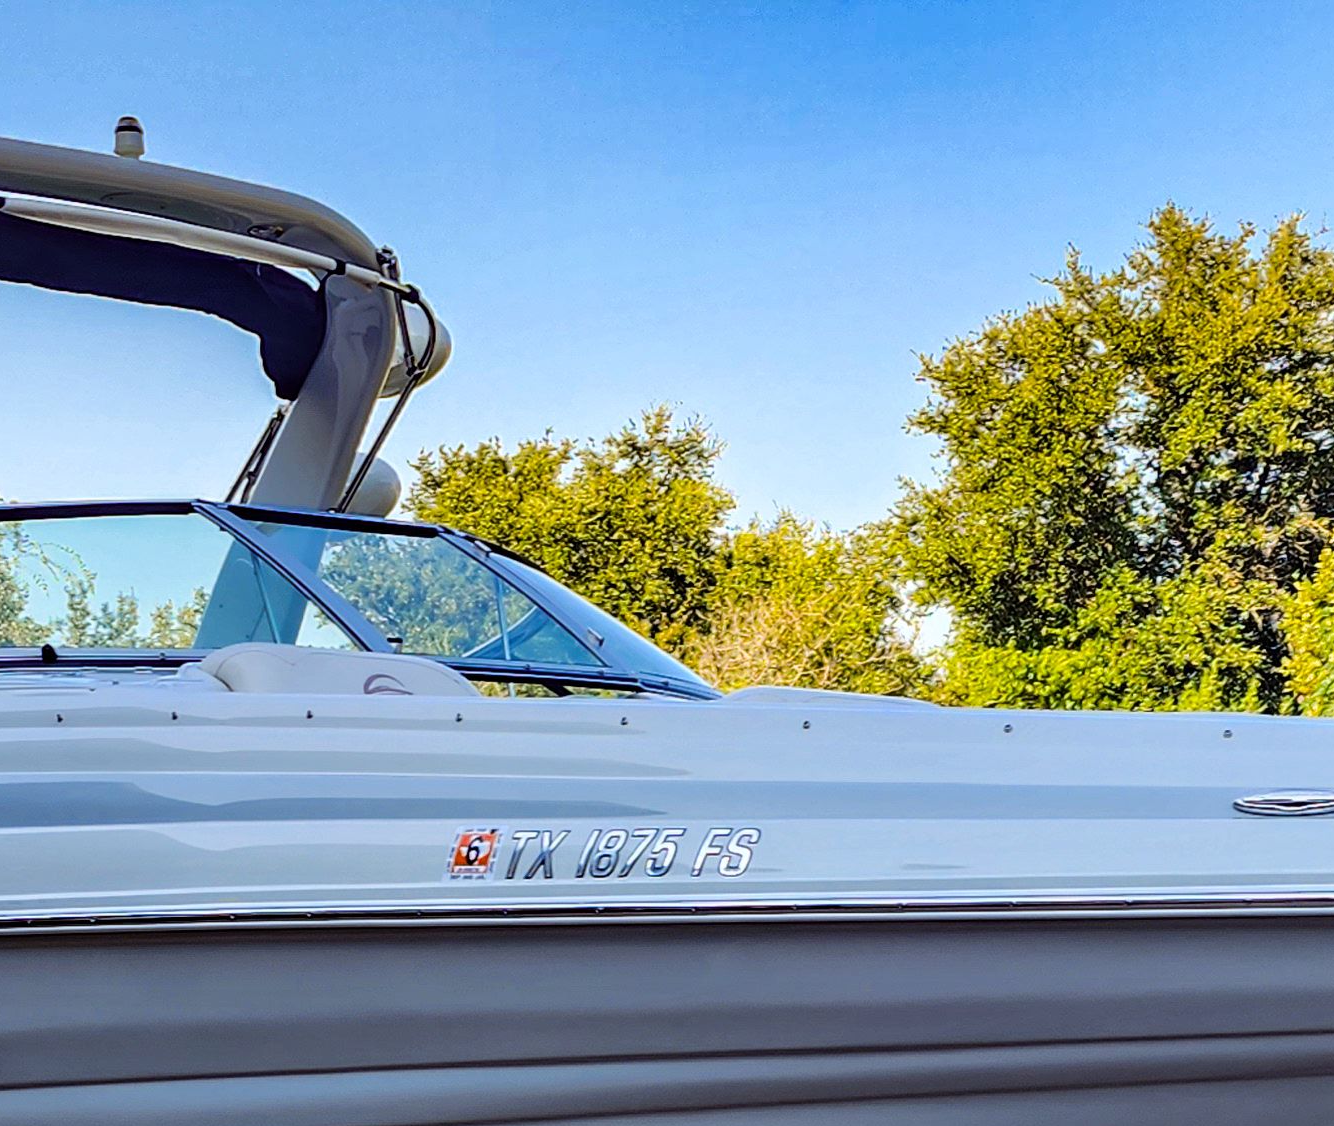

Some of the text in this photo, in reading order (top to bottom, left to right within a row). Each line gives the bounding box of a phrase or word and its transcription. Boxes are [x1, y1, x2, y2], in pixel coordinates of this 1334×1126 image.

[466, 836, 484, 866] 6
[505, 827, 762, 880] TX 1875 FS
